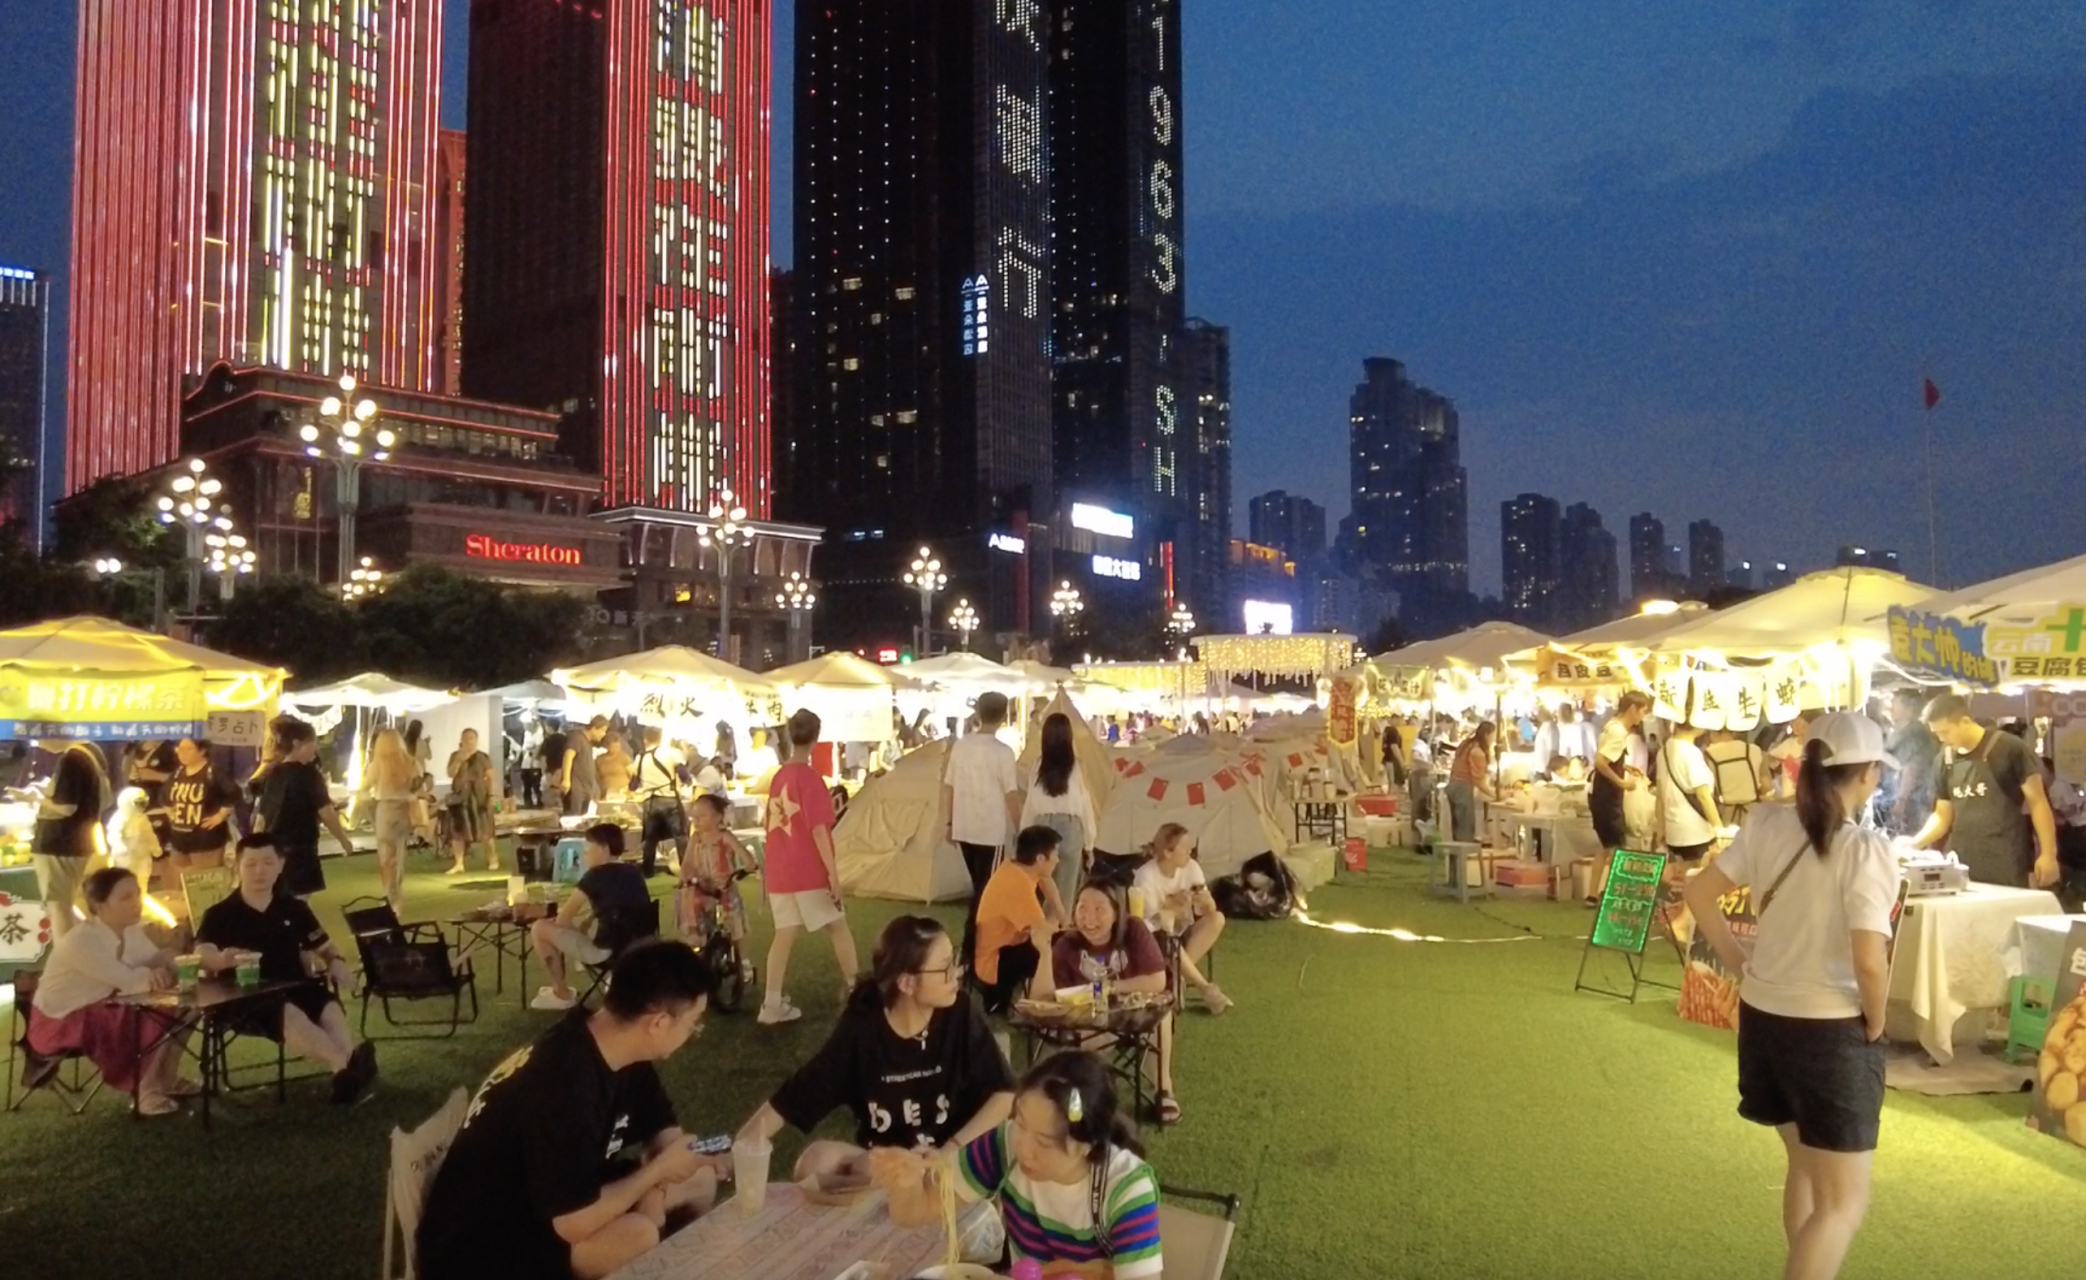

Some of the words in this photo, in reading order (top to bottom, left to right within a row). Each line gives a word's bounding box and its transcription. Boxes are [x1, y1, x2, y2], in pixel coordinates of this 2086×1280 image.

[465, 534, 581, 566] Sheraton
[1992, 631, 2053, 655] 云南
[640, 692, 704, 718] 烈火
[0, 911, 32, 946] 茶
